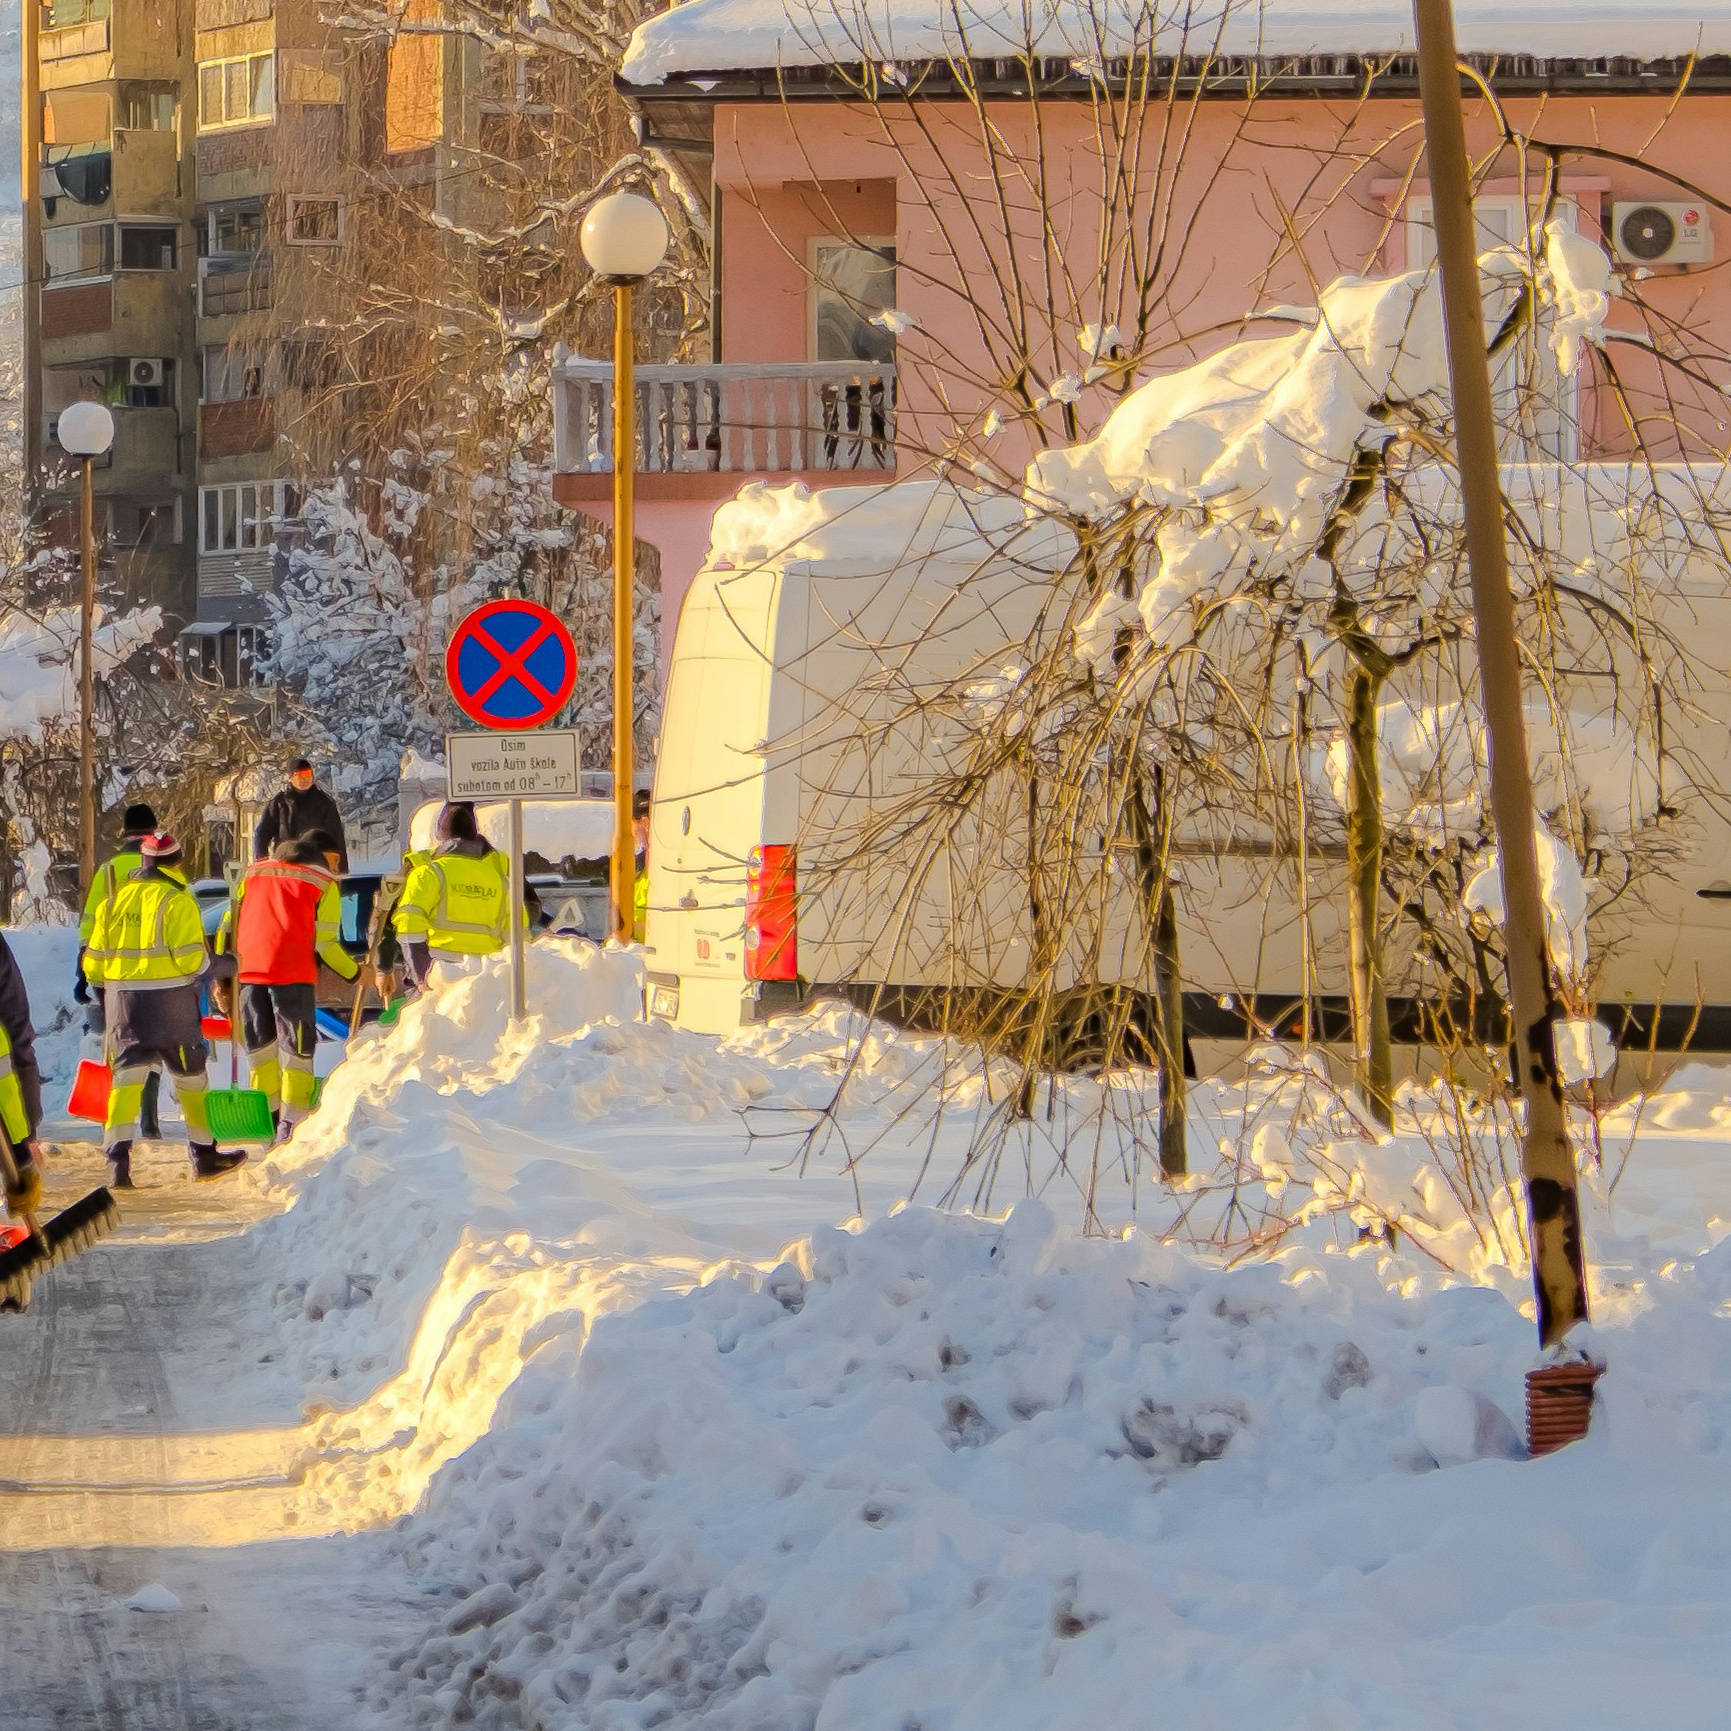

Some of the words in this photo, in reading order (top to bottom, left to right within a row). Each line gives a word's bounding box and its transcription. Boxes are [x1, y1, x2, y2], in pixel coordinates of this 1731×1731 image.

[501, 739, 526, 752] Osim
[471, 760, 500, 771] vozila
[503, 758, 526, 771] Auto
[530, 757, 557, 769] škole
[457, 780, 501, 793] subotom
[504, 779, 516, 791] od
